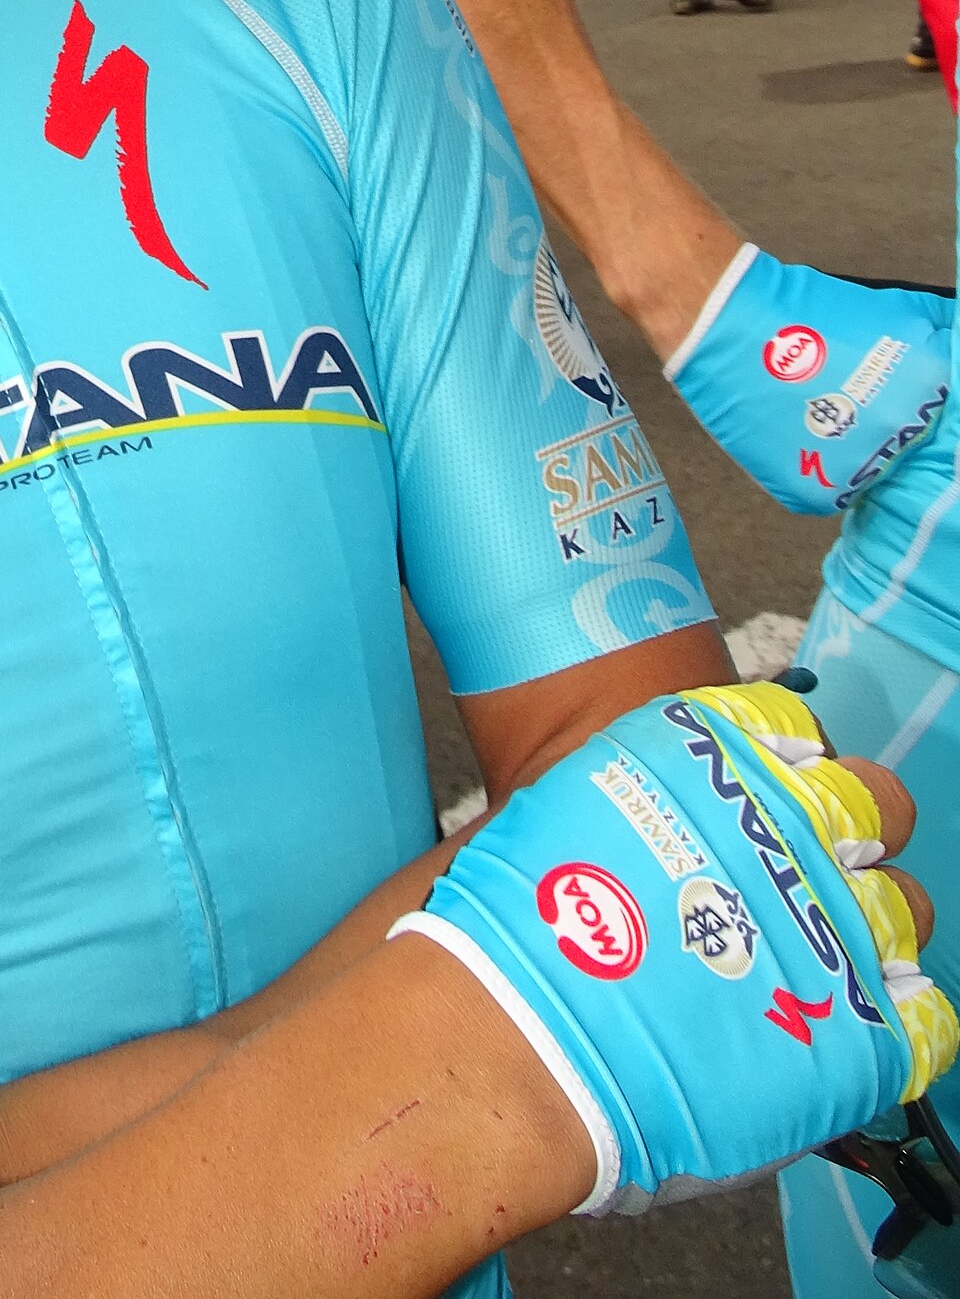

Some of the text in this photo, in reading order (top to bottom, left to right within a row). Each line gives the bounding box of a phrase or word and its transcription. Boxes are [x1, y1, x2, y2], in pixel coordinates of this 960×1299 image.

[776, 335, 814, 372] MOA
[602, 767, 690, 875] SAMRUK
[618, 756, 706, 866] KAZYNA
[663, 701, 886, 1024] ASTANA
[561, 876, 624, 956] MOA
